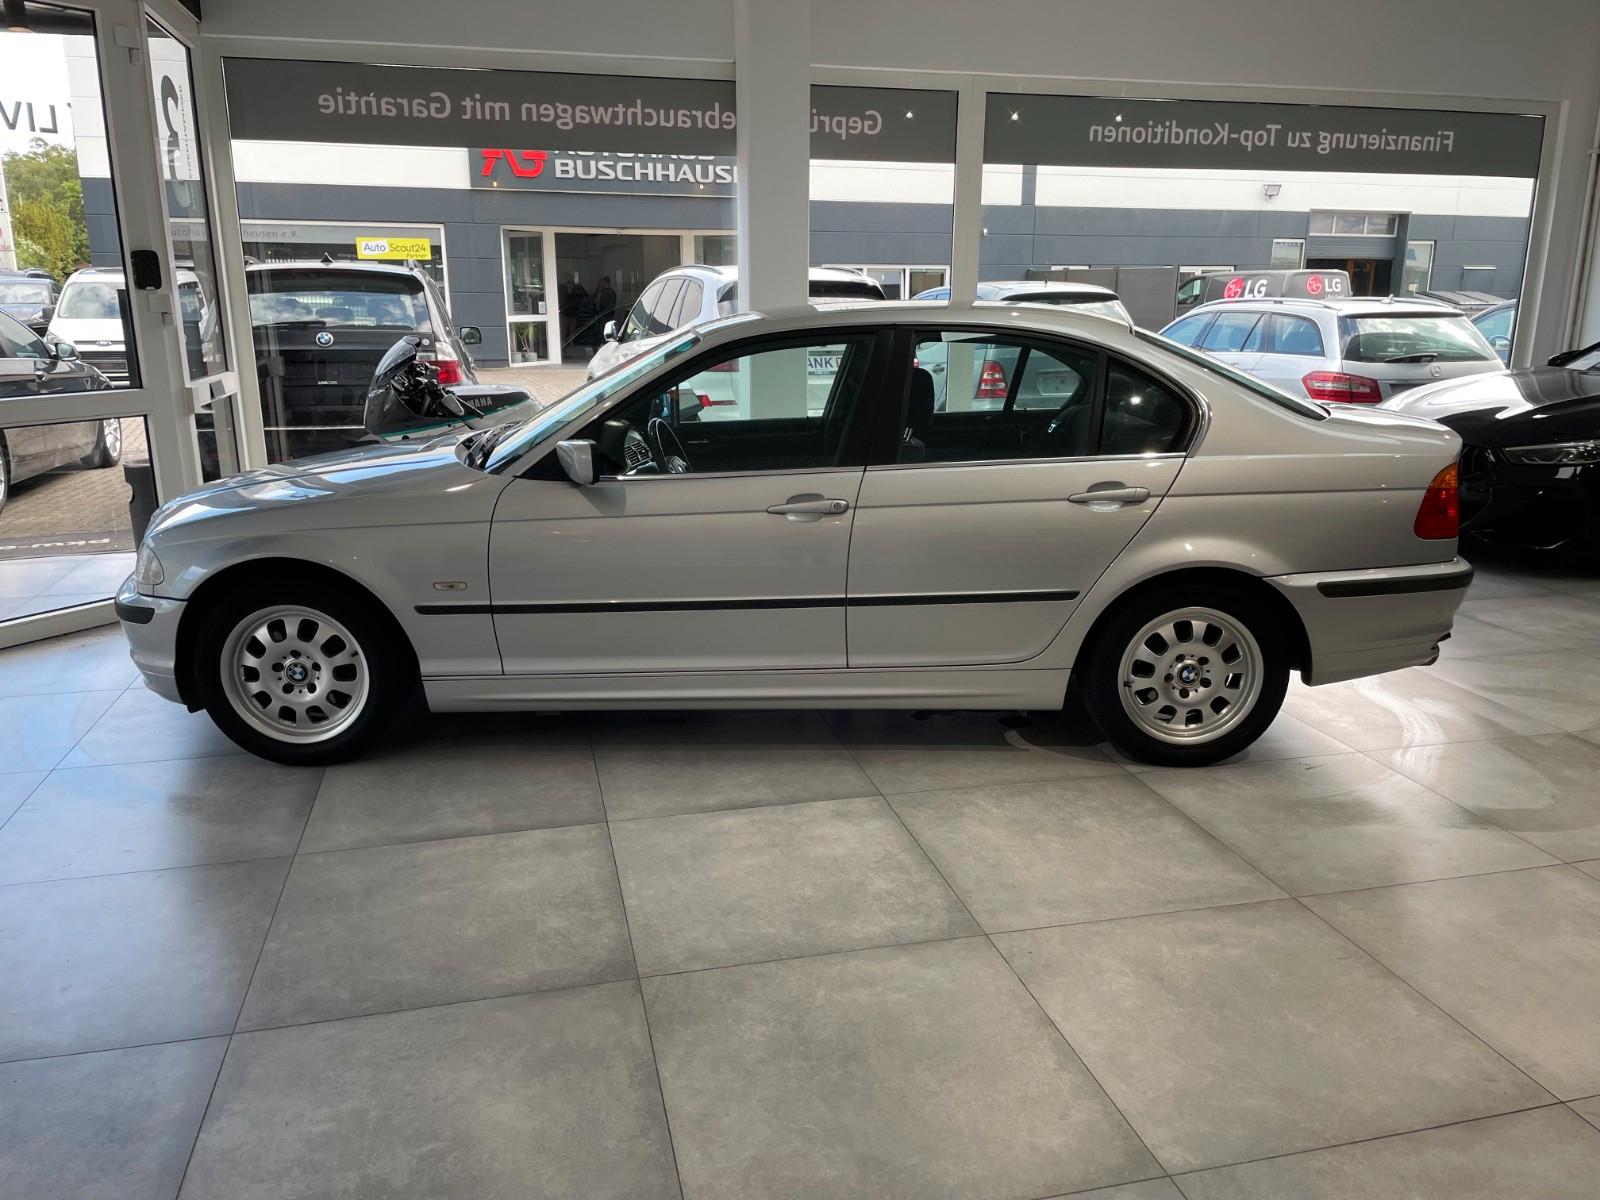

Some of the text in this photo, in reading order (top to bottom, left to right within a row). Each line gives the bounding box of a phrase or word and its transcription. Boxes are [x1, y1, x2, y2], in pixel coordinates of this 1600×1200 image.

[363, 243, 426, 252] Auto Scout24
[1244, 280, 1268, 298] LG
[1324, 278, 1341, 292] LG
